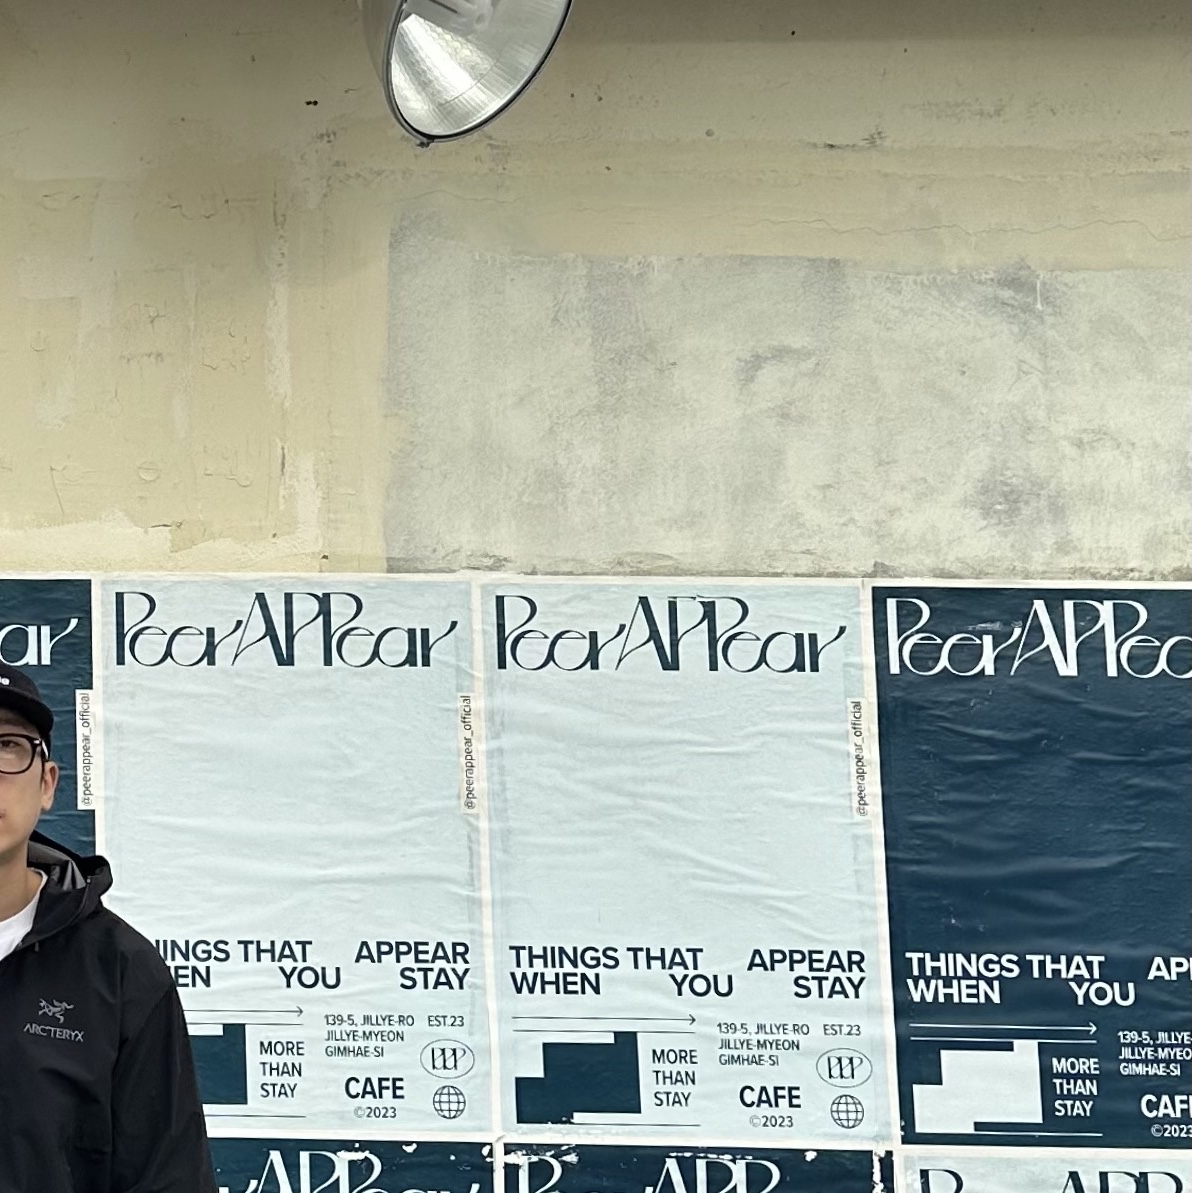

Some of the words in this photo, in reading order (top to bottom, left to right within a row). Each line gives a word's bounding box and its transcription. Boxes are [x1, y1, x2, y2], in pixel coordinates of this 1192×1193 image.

[115, 592, 458, 668] PeerAPPear
[496, 595, 846, 673] PeerAPPear
[81, 693, 94, 807] @peerappear_official
[462, 696, 476, 809] @peerappear_official
[854, 701, 868, 816] @peerappear_official
[156, 939, 230, 962] INGS
[238, 940, 312, 962] THAT
[355, 941, 469, 964] APPEAR
[509, 946, 619, 969] THINGS
[627, 947, 703, 970] THAT
[747, 949, 865, 972] APPEAR
[906, 952, 1019, 977] THINGS
[1026, 955, 1105, 979] THAT
[279, 966, 340, 989] YOU
[400, 967, 470, 990] STAY
[510, 972, 600, 995] WHEN
[669, 974, 733, 997] YOU
[794, 976, 865, 999] STAY
[907, 979, 1000, 1003] WHEN
[1069, 982, 1135, 1006] YOU
[324, 1014, 357, 1027] 139-5,
[361, 1015, 414, 1026] JILLYE-RO
[428, 1015, 464, 1027] EST.23
[325, 1030, 404, 1042] JILLYE-MYEON
[717, 1023, 752, 1034] 139-5,
[755, 1023, 809, 1035] JILLYE-RO
[823, 1024, 861, 1036] EST.23
[719, 1039, 800, 1051] JILLYE-MYEON
[1118, 1031, 1153, 1045] 139-5,
[260, 1041, 304, 1056] MORE
[325, 1046, 384, 1057] GIMHAE-SI
[652, 1049, 697, 1064] MORE
[719, 1054, 779, 1066] GIMHAE-SI
[1052, 1058, 1099, 1074] MORE
[260, 1062, 301, 1077] THAN
[1120, 1063, 1180, 1075] GIMHAE-SI
[653, 1070, 695, 1085] THAN
[261, 1083, 297, 1098] STAY
[345, 1077, 404, 1099] CAFE
[1053, 1079, 1097, 1095] THAN
[654, 1091, 691, 1106] STAY
[740, 1086, 801, 1108] CAFE
[1055, 1100, 1093, 1116] STAY
[1140, 1094, 1192, 1118] CAF
